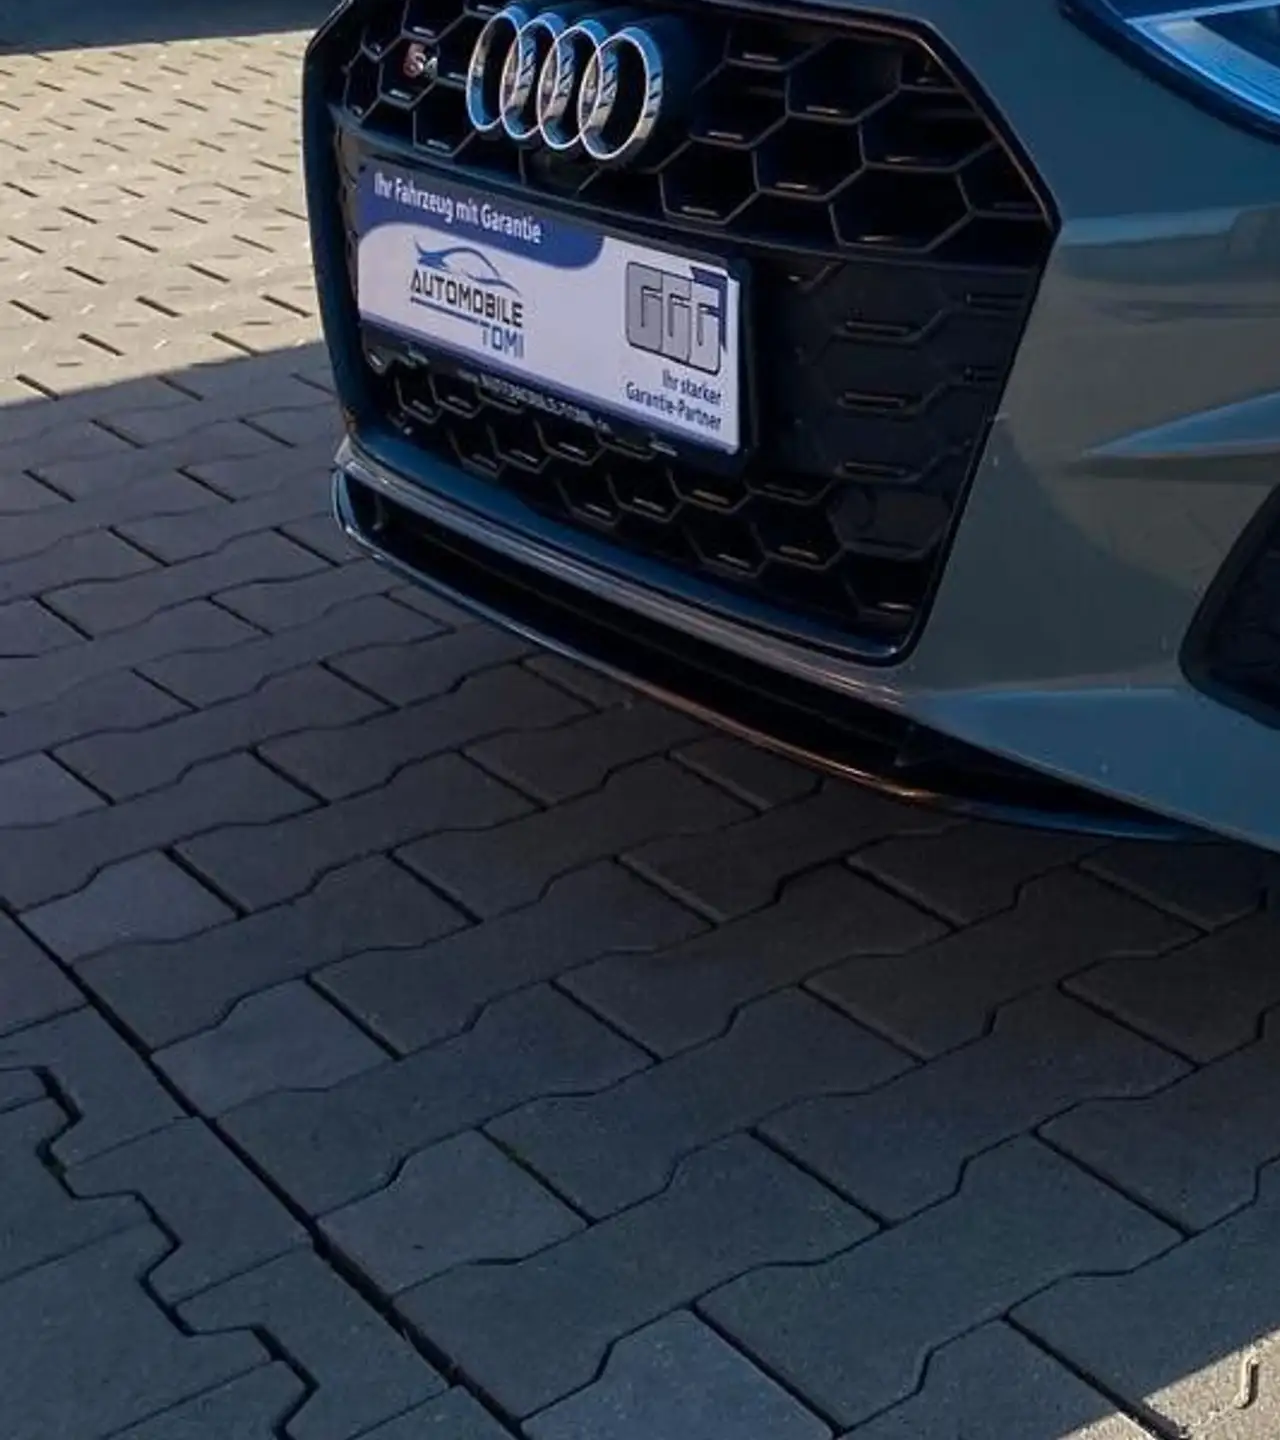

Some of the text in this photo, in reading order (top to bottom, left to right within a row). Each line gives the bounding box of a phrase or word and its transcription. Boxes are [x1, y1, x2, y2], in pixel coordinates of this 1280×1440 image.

[374, 171, 542, 244] Ihr Fahrzeug mit Garantie
[410, 269, 523, 328] AUTOMOBILE
[479, 320, 525, 359] TOMI
[626, 381, 721, 431] Garantie-Partner
[663, 369, 721, 405] Ihr starker
